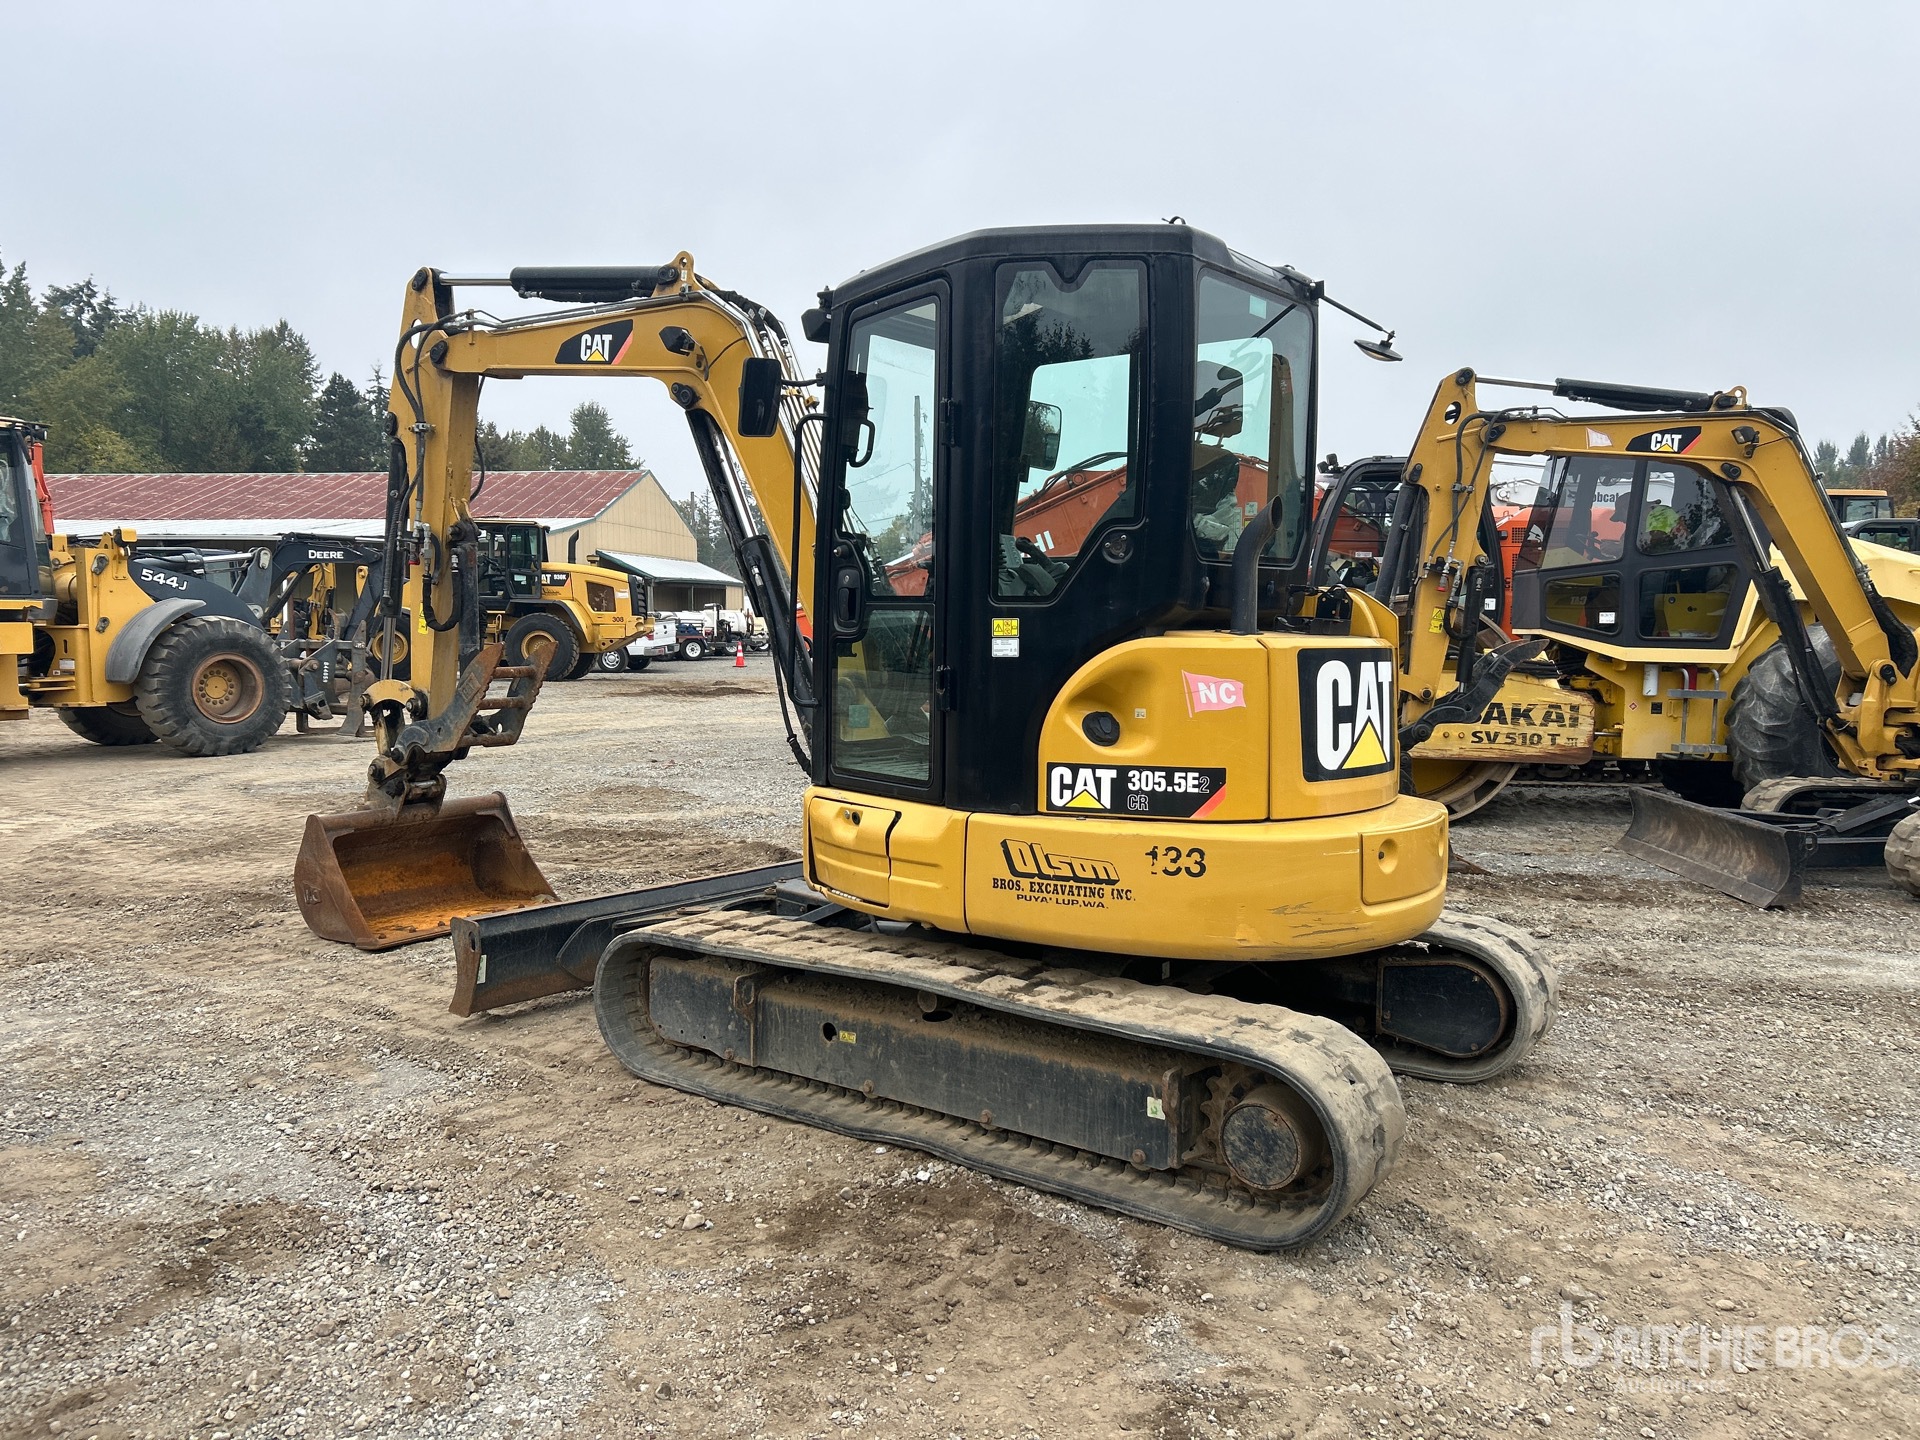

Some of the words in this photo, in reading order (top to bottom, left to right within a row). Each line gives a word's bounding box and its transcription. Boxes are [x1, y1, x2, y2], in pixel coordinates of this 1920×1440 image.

[580, 333, 613, 362] CAT
[1650, 433, 1682, 452] CAT
[308, 550, 344, 559] DEERE
[140, 568, 188, 591] 544J
[1197, 682, 1237, 704] NC
[1316, 660, 1392, 770] CAT
[1480, 703, 1580, 728] AKAI
[1471, 731, 1500, 744] SV
[1050, 766, 1117, 809] CAT
[1127, 794, 1149, 811] CR
[1000, 838, 1120, 886] Olson
[992, 877, 1025, 892] BROS.
[1029, 881, 1105, 899] EXCAVATING
[1110, 888, 1136, 901] INC.
